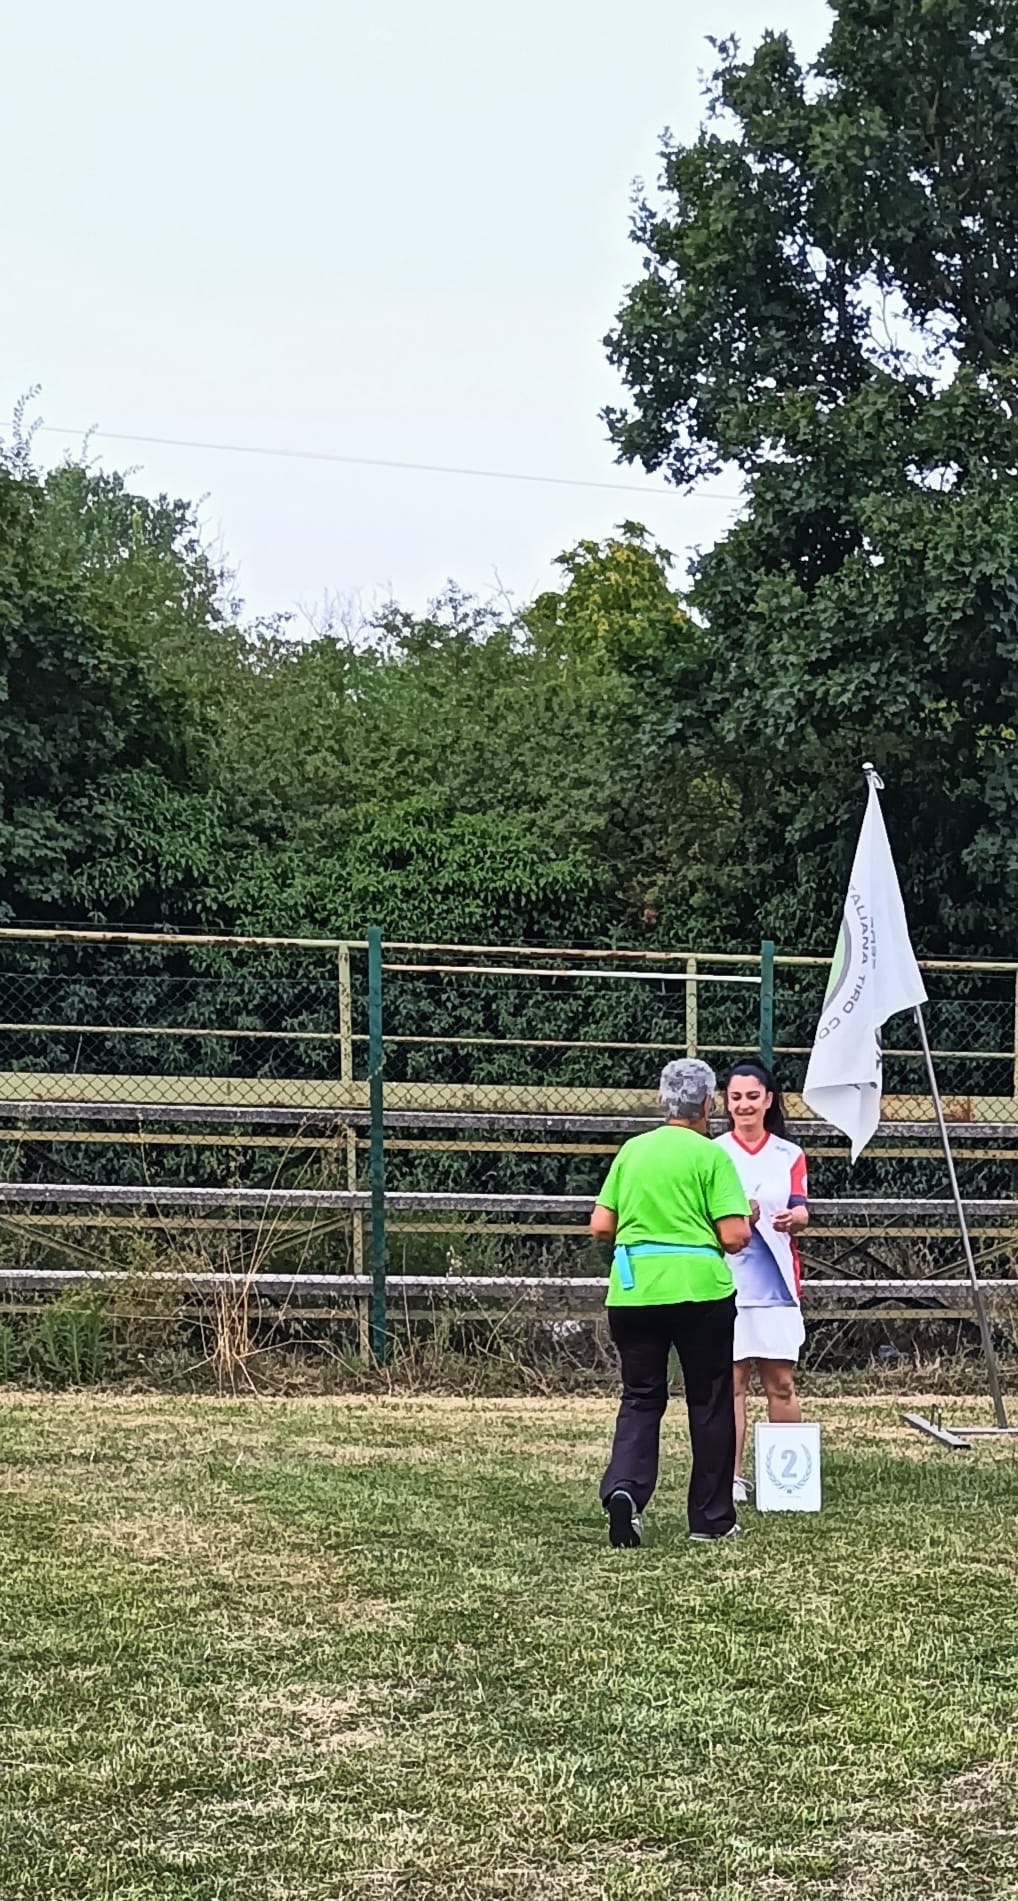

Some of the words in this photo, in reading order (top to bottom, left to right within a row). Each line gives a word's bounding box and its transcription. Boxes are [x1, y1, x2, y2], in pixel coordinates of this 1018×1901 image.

[843, 975, 865, 1014] TIRO
[816, 1017, 841, 1042] CO
[780, 1449, 798, 1478] 2
